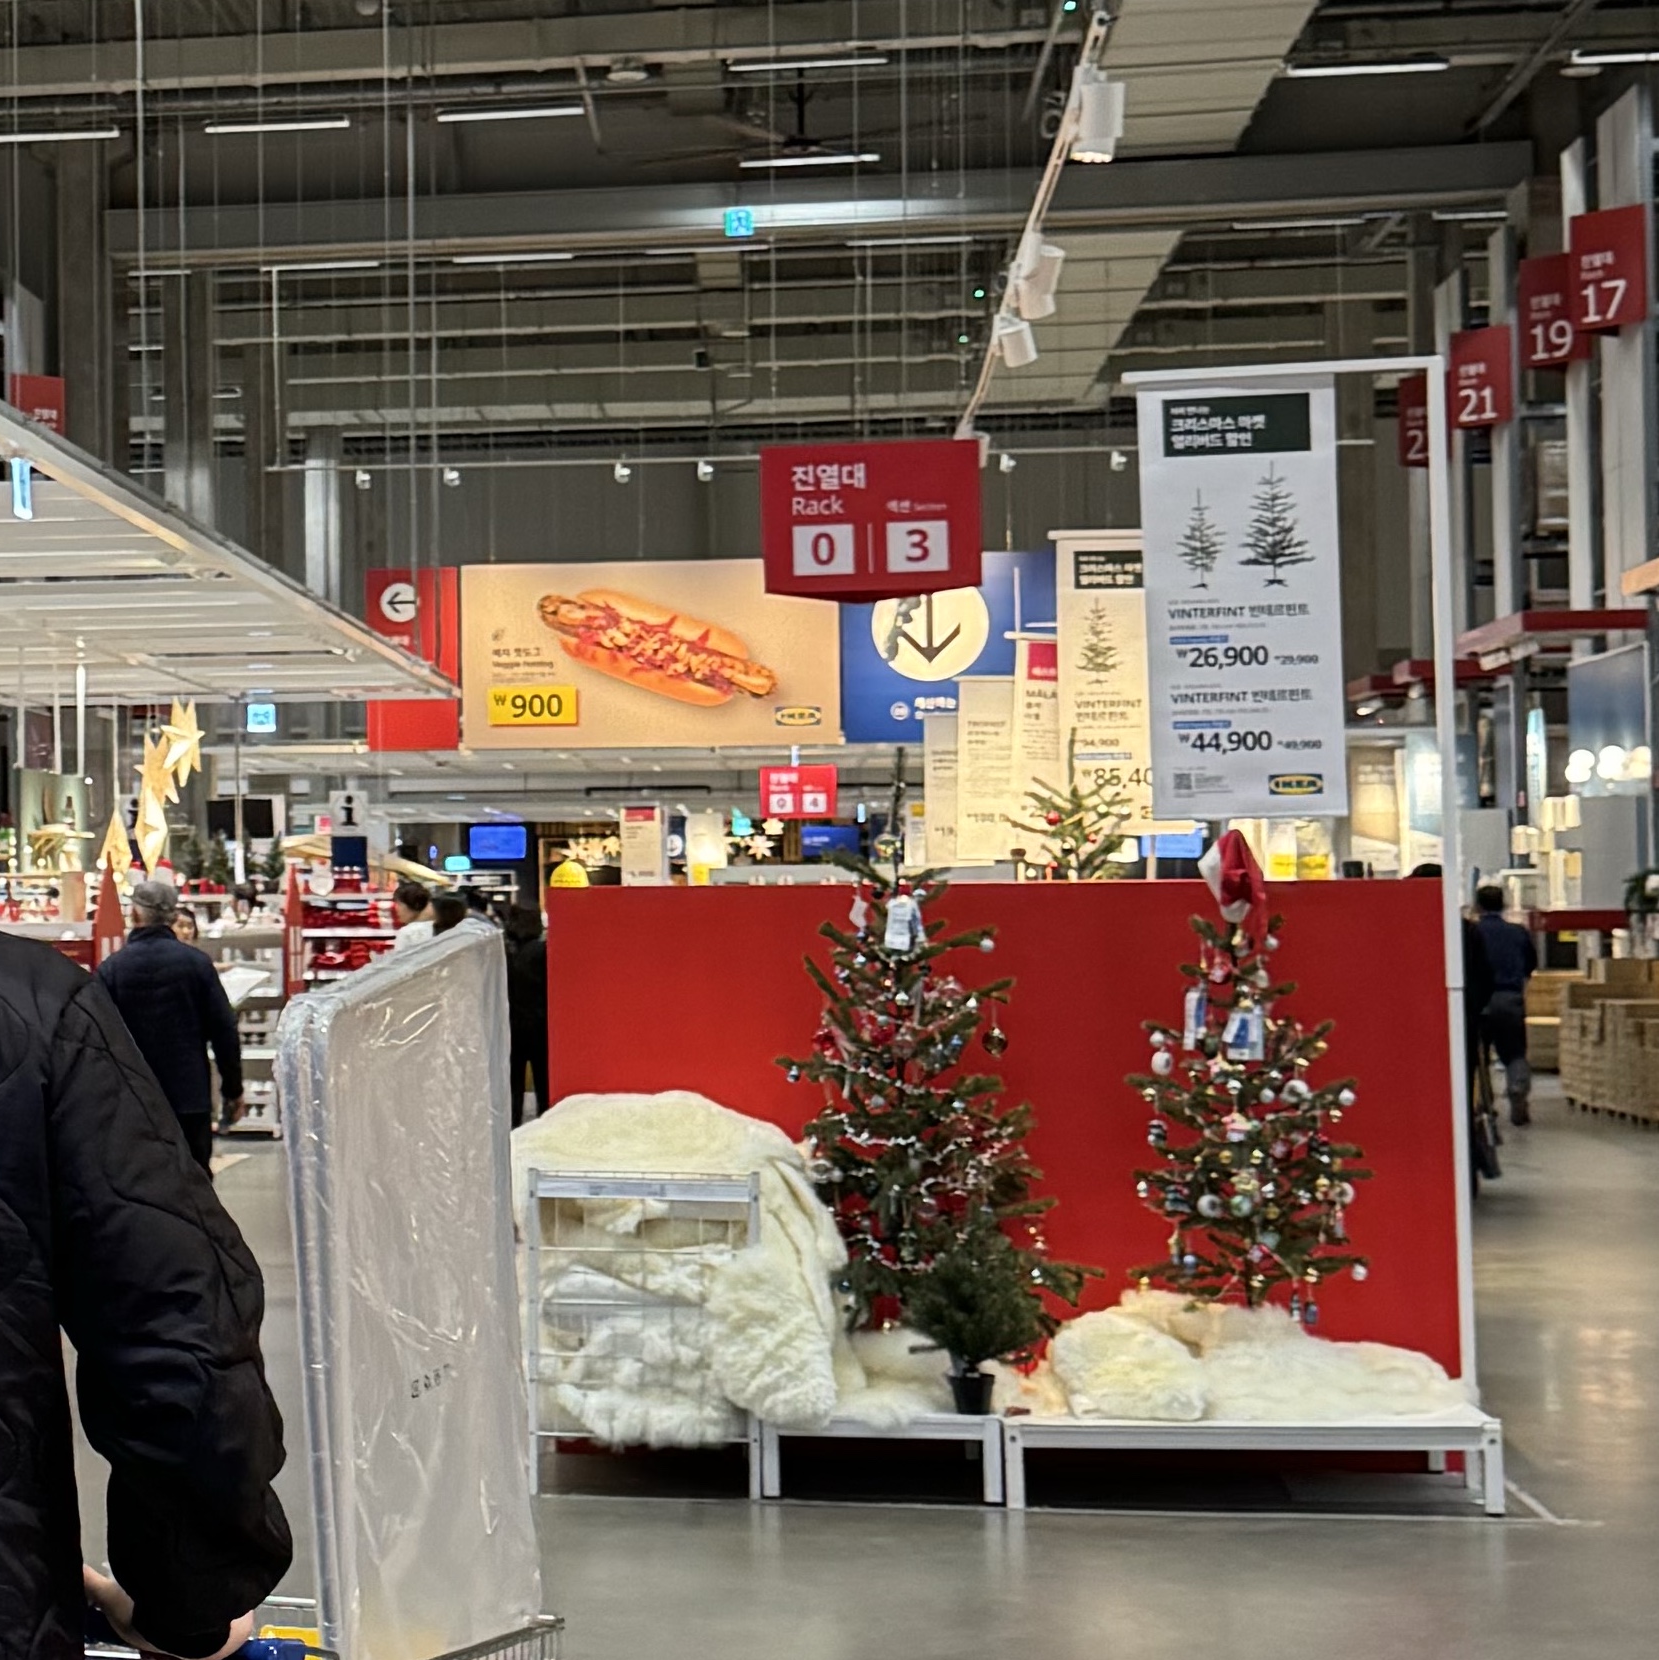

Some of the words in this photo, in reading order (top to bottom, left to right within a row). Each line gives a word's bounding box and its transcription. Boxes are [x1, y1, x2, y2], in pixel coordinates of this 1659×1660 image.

[1580, 279, 1627, 323] 17
[1530, 319, 1573, 361] 19
[1457, 386, 1499, 423] 21
[1170, 416, 1236, 432] 크리스마스
[1406, 428, 1429, 460] 2
[792, 463, 867, 491] 진열대
[792, 494, 844, 516] Rack
[811, 532, 835, 566] 0
[905, 529, 930, 562] 3
[1168, 605, 1245, 620] VINTERFINT
[1176, 645, 1269, 670] ₩26,900
[493, 694, 563, 718] ₩900
[1074, 698, 1142, 710] VINTERFINT
[1170, 691, 1248, 705] VINTERFINT
[1178, 730, 1273, 755] ₩44,900
